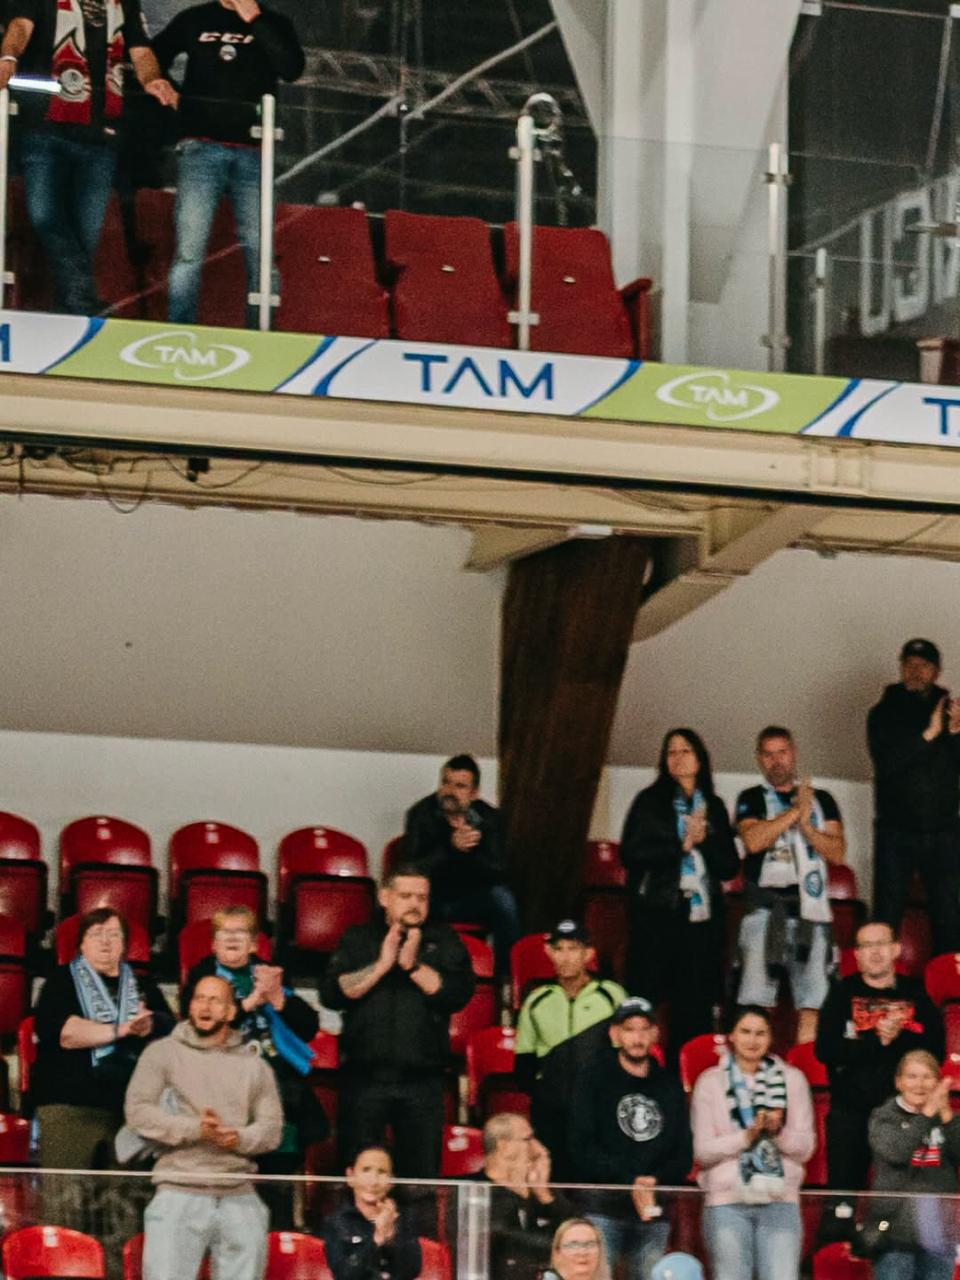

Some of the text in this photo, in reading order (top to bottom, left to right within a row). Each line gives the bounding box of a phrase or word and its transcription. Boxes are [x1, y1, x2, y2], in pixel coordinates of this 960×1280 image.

[153, 344, 218, 368] TAM
[403, 352, 554, 401] TAM
[688, 384, 750, 410] TAM
